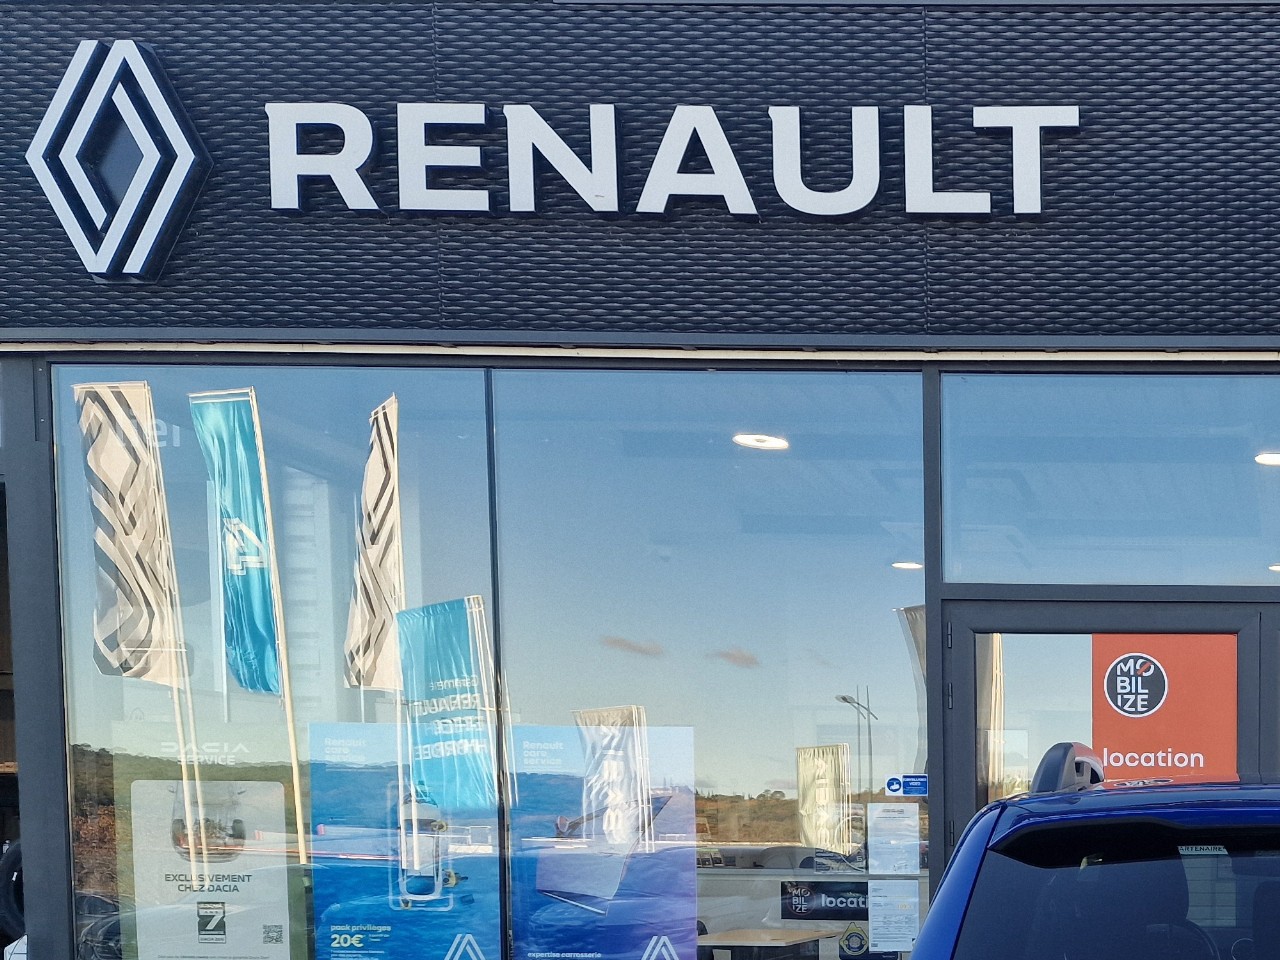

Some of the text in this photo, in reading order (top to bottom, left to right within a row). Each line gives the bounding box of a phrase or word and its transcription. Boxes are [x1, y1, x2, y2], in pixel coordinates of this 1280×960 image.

[265, 102, 1080, 215] RENAULT
[1103, 748, 1204, 767] location
[207, 884, 240, 893] DACIA
[330, 934, 364, 948] 20€
